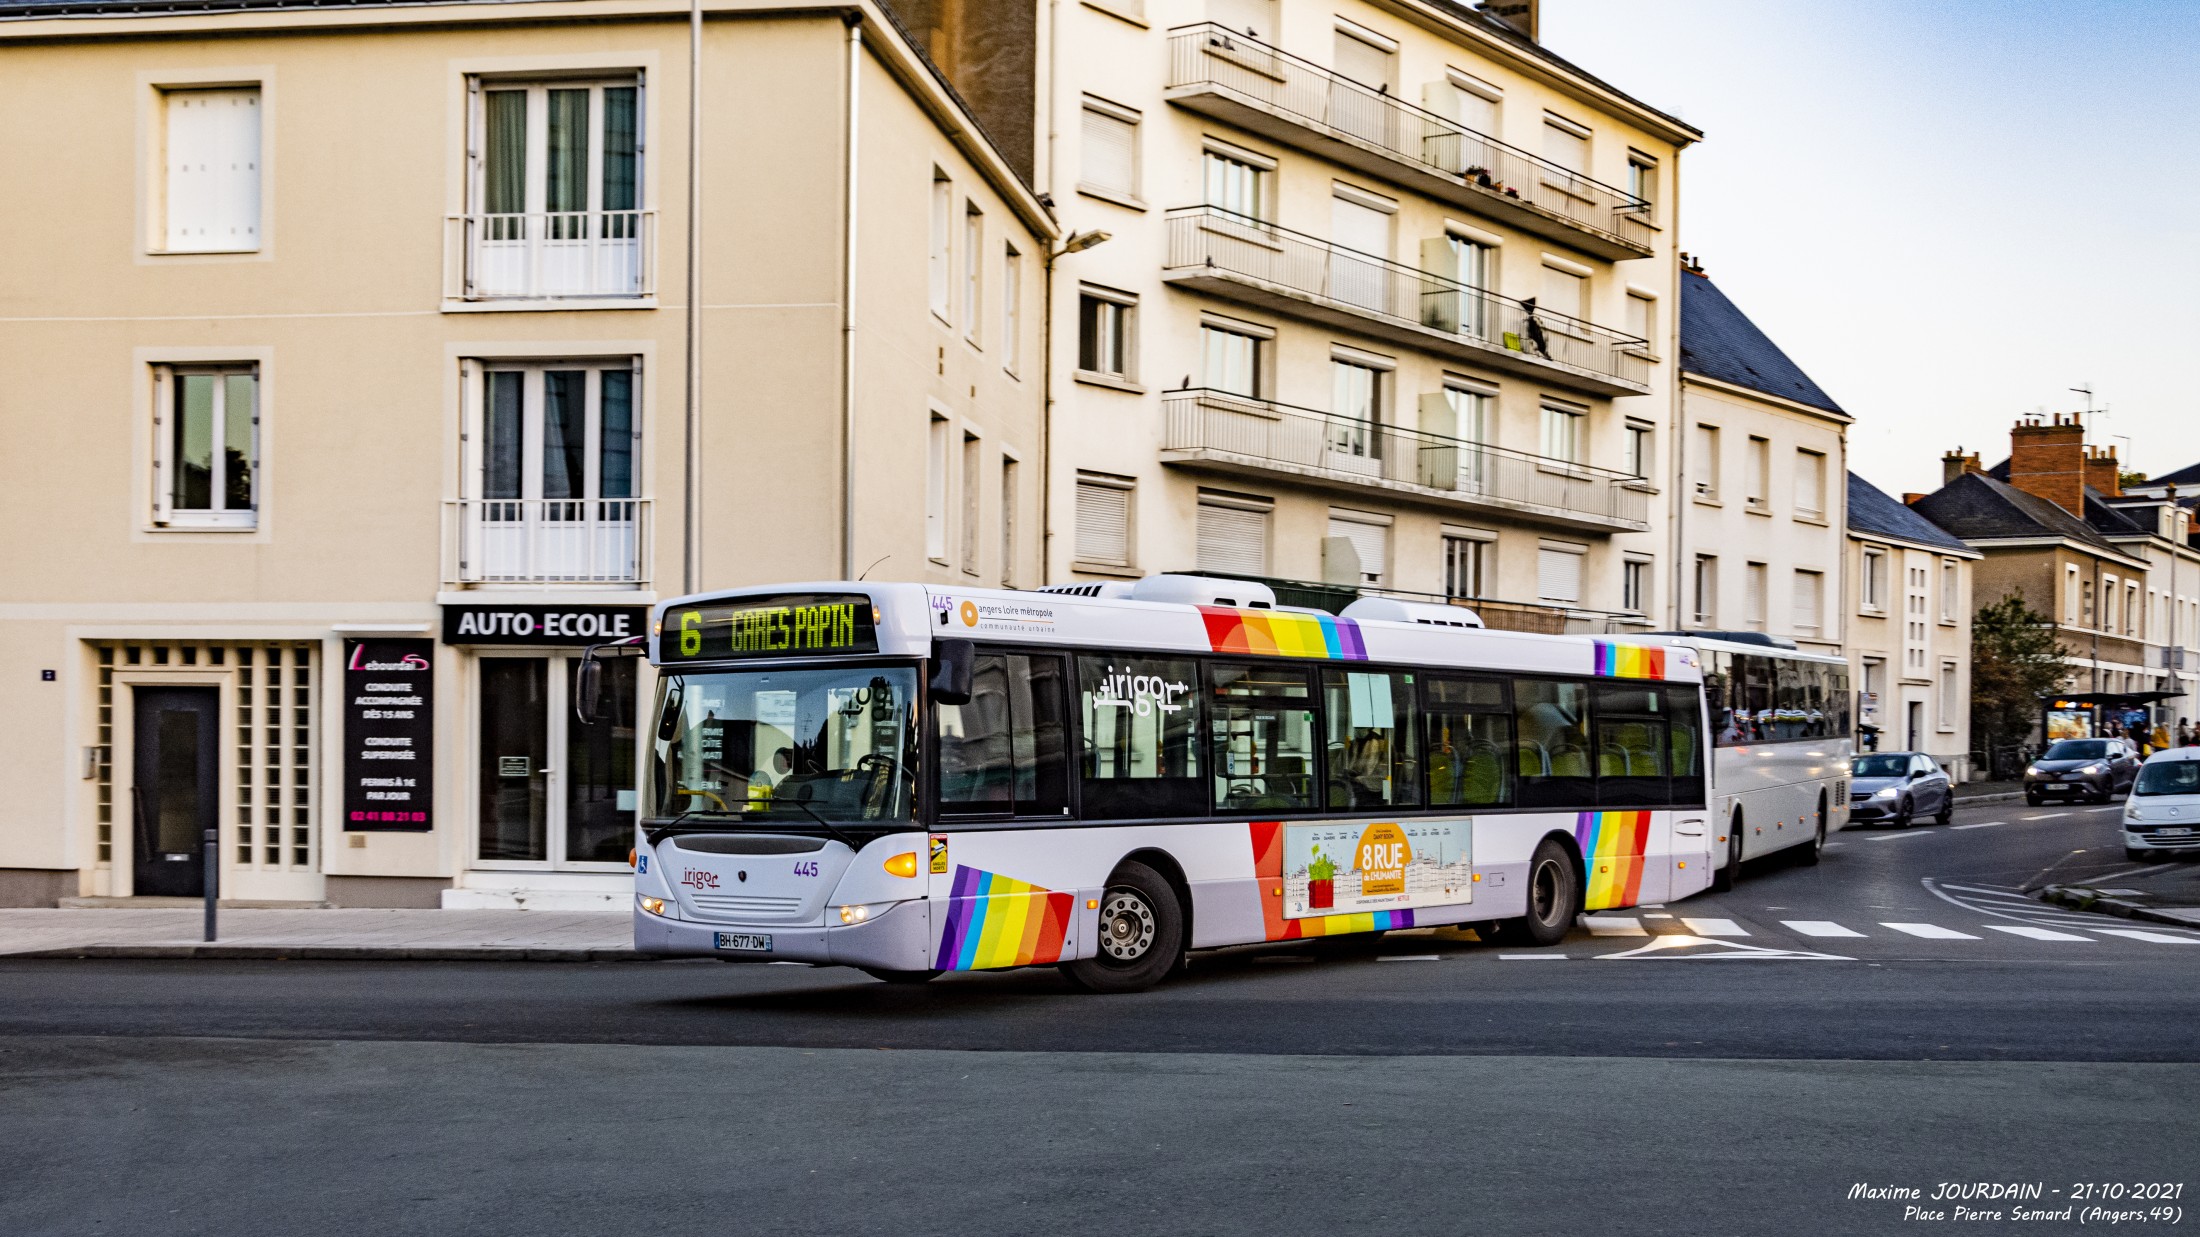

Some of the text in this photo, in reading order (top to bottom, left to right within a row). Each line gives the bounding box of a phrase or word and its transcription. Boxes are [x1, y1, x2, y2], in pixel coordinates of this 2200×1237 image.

[931, 595, 953, 611] 445
[978, 605, 1053, 619] angers loire métropole
[457, 612, 630, 637] AUTO-ECOLE
[680, 603, 854, 656] 6 GARES PAPIN
[980, 622, 1025, 632] communauté
[365, 683, 413, 692] CONDUITE
[394, 710, 415, 719] ANS
[364, 737, 413, 746] CONDUITE
[1362, 842, 1403, 870] 8 RUE
[793, 861, 818, 877] 445
